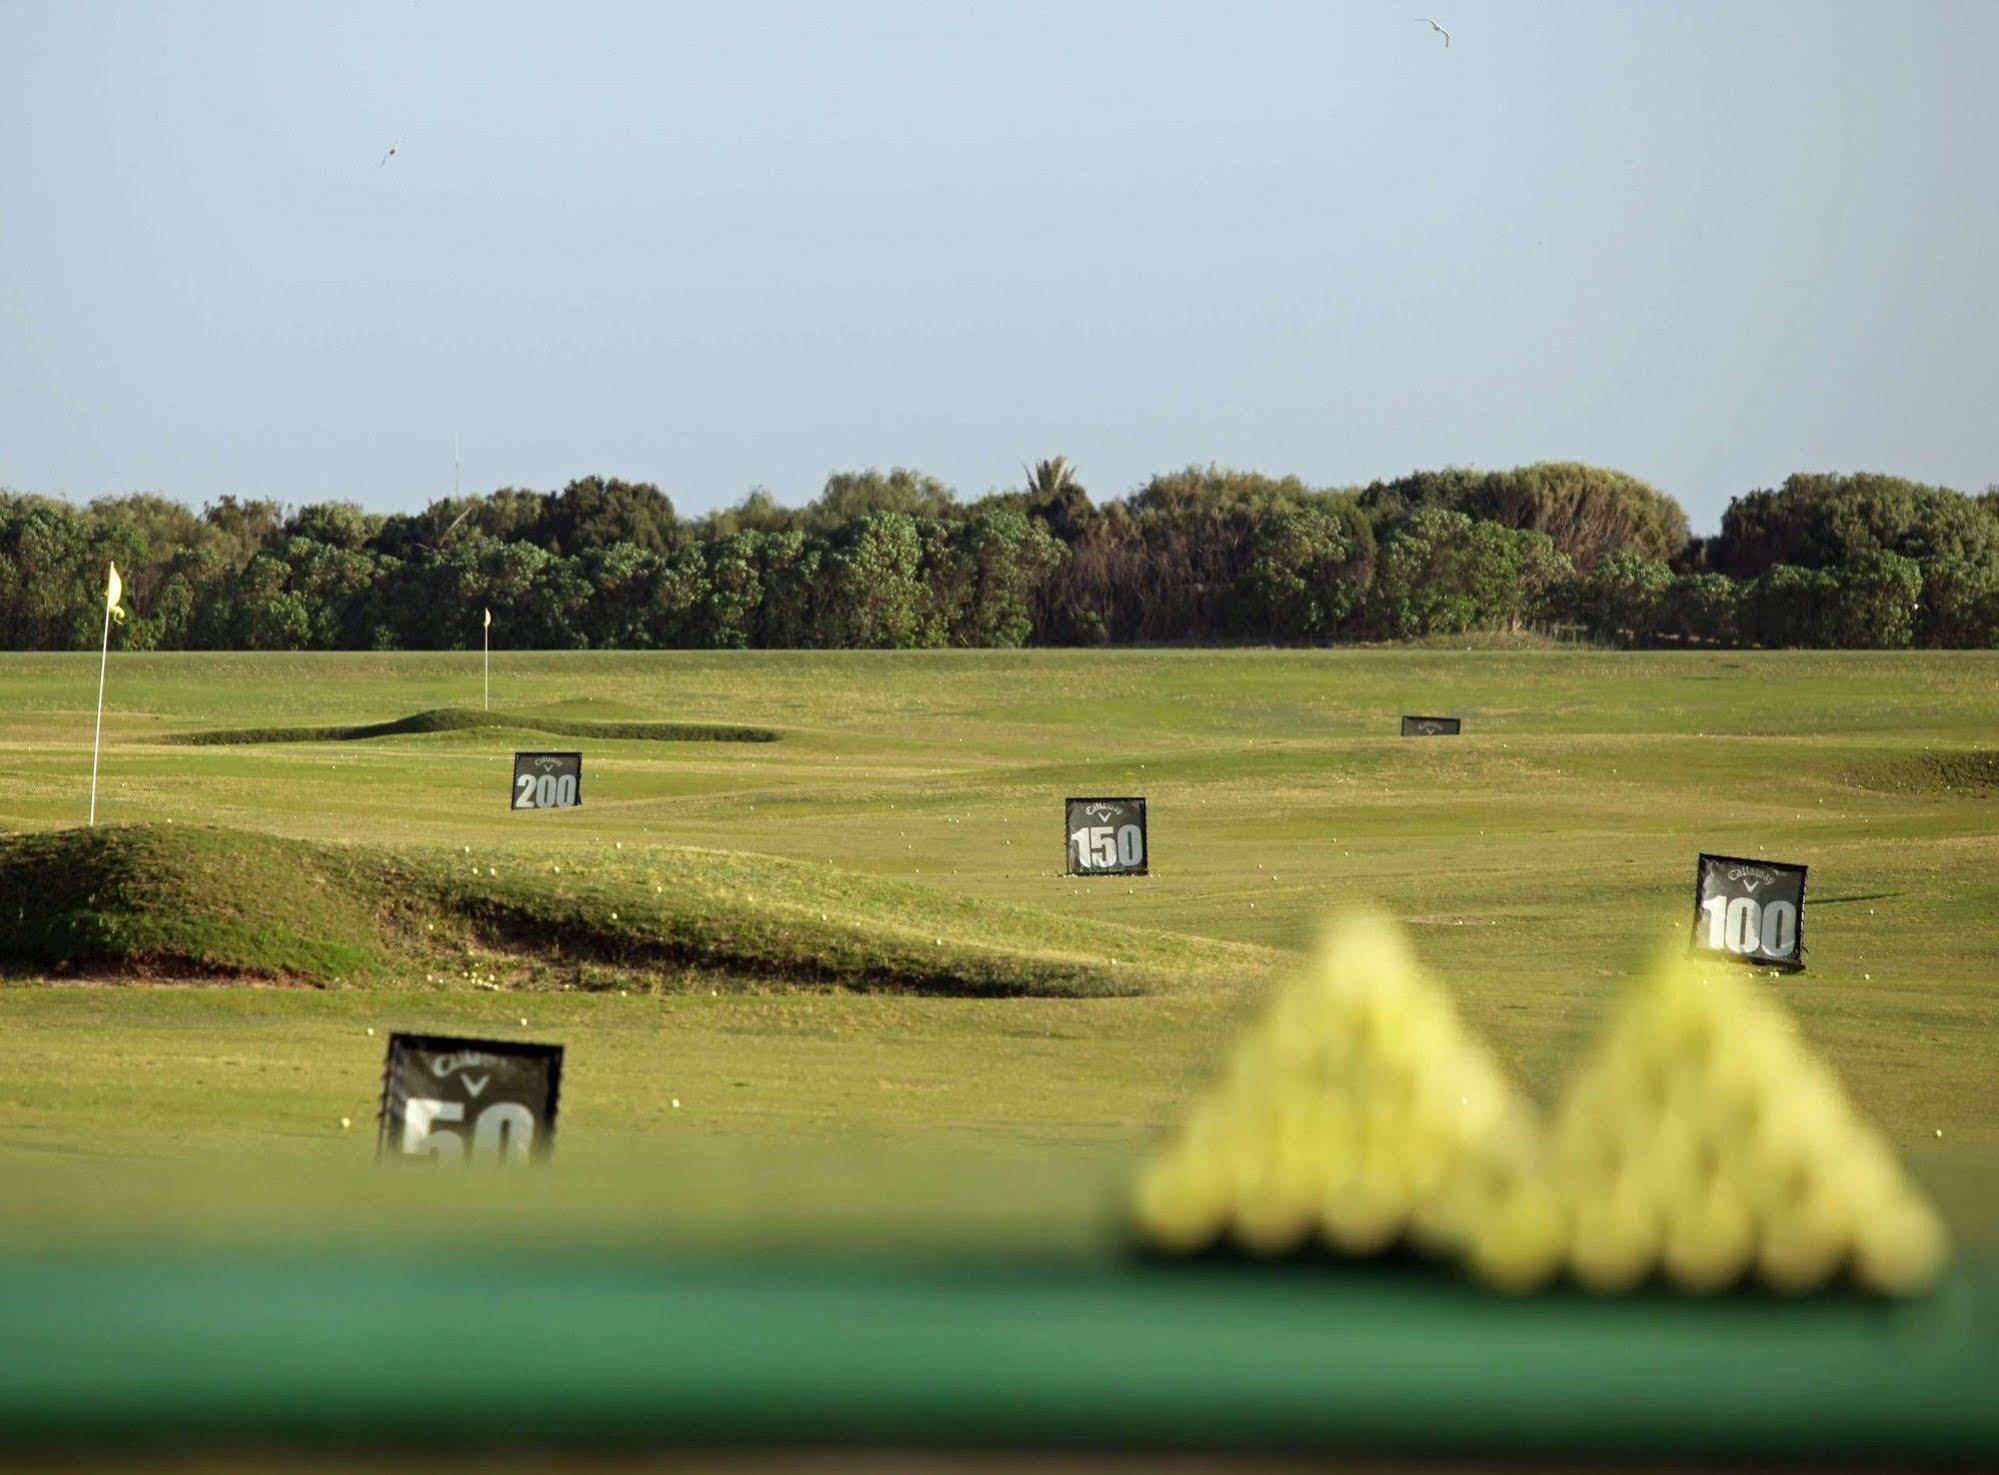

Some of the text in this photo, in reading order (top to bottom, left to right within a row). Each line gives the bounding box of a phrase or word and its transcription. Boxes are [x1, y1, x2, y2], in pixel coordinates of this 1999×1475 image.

[515, 774, 577, 808] 200
[1085, 802, 1123, 815] Callaway
[1070, 824, 1143, 868] 150
[1728, 865, 1775, 885] Callaway
[1702, 895, 1796, 957] 100
[403, 1098, 535, 1165] 50
